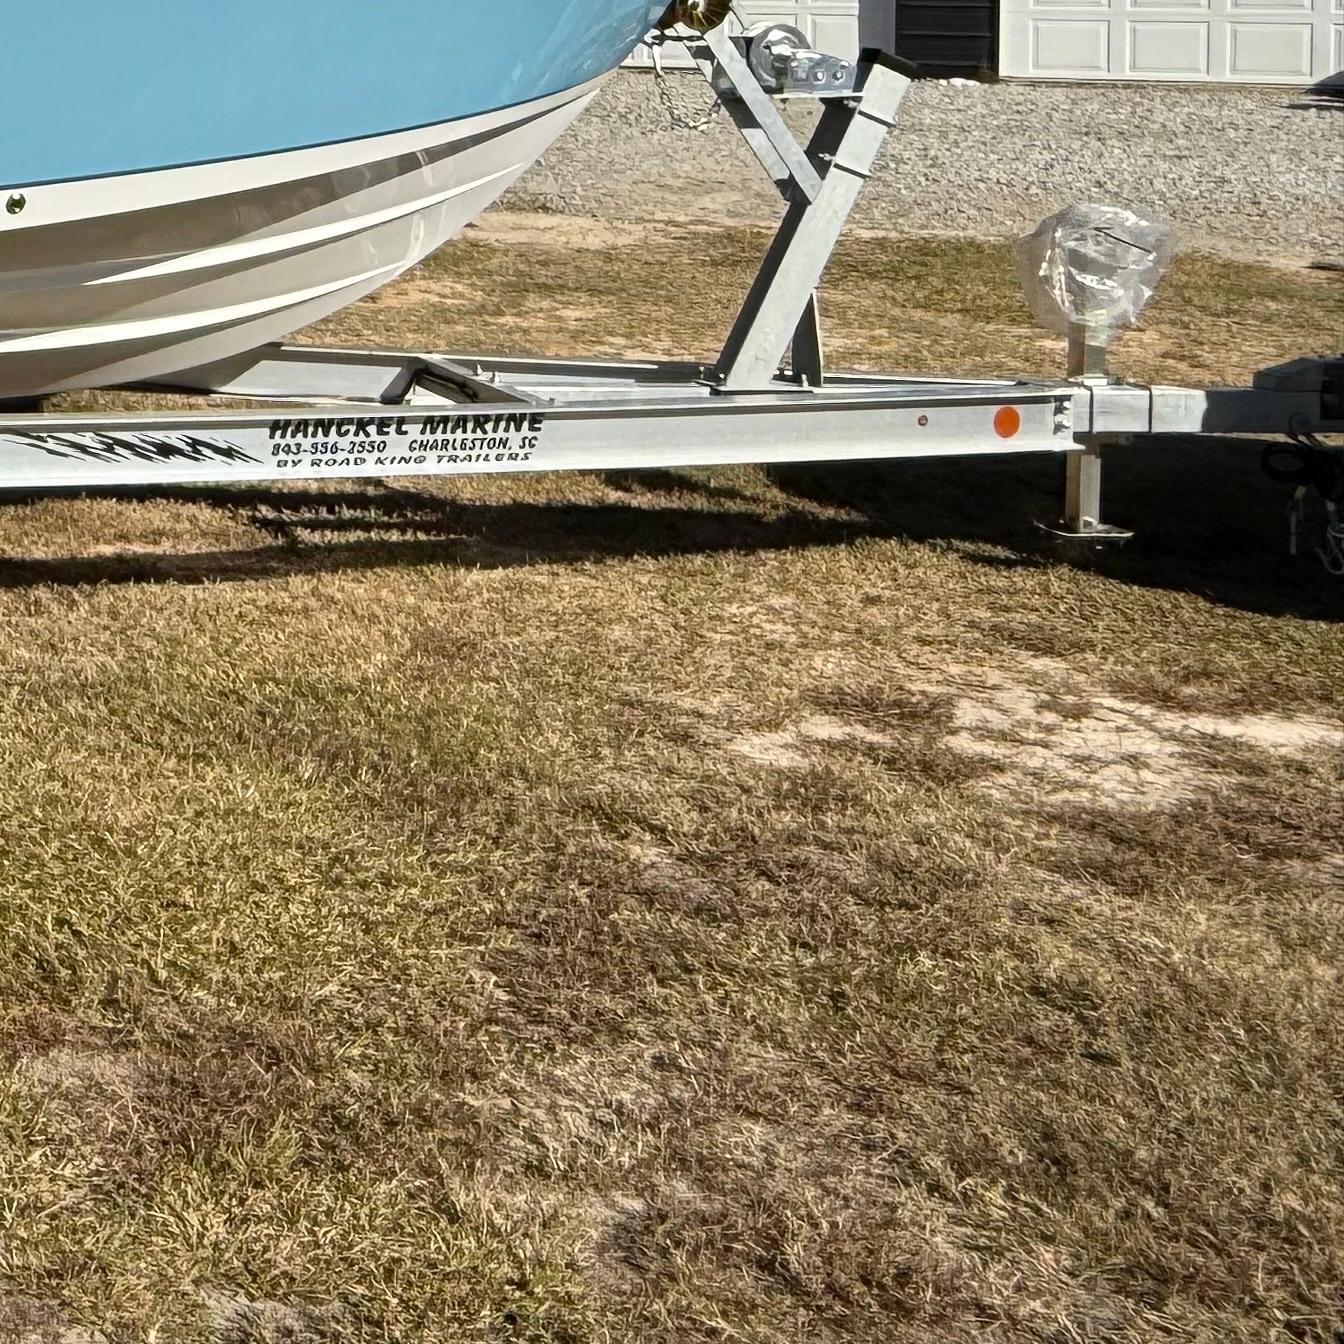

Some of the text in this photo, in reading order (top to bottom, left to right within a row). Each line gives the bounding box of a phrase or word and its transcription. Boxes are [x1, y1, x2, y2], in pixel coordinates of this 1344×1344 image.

[269, 412, 545, 439] HANCKEL MARINE
[519, 435, 539, 449] SC
[277, 452, 532, 468] BY ROAD KING TRAILERS
